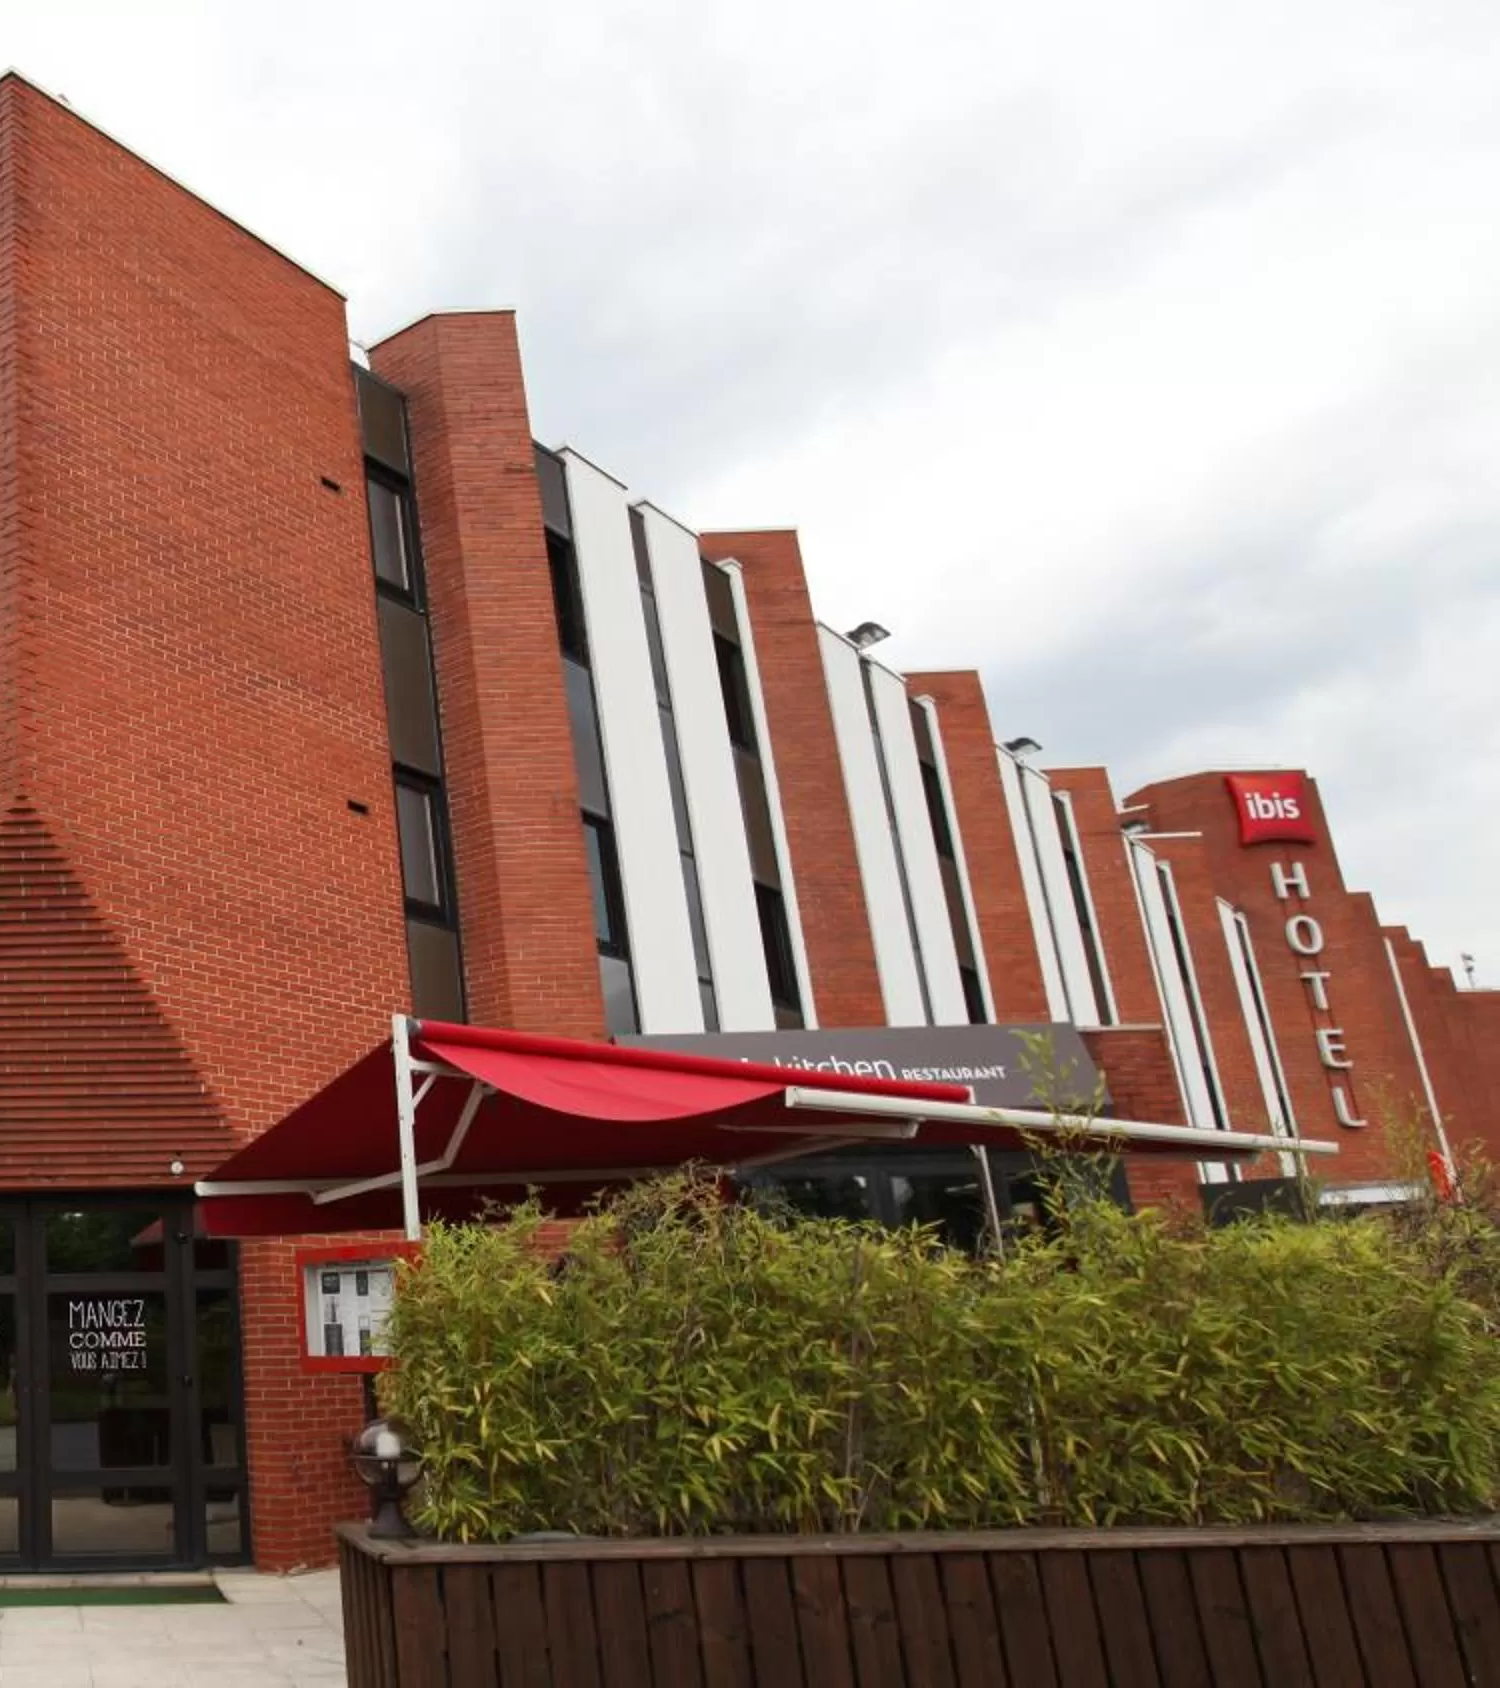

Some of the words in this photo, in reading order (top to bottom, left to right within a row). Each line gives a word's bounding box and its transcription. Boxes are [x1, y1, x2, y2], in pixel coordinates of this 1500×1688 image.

[1246, 792, 1300, 819] ibis
[1270, 862, 1367, 1128] HOTEL
[901, 1065, 1005, 1081] RESTAURANT
[69, 1300, 145, 1328] MANGEZ
[69, 1332, 146, 1349] COMME
